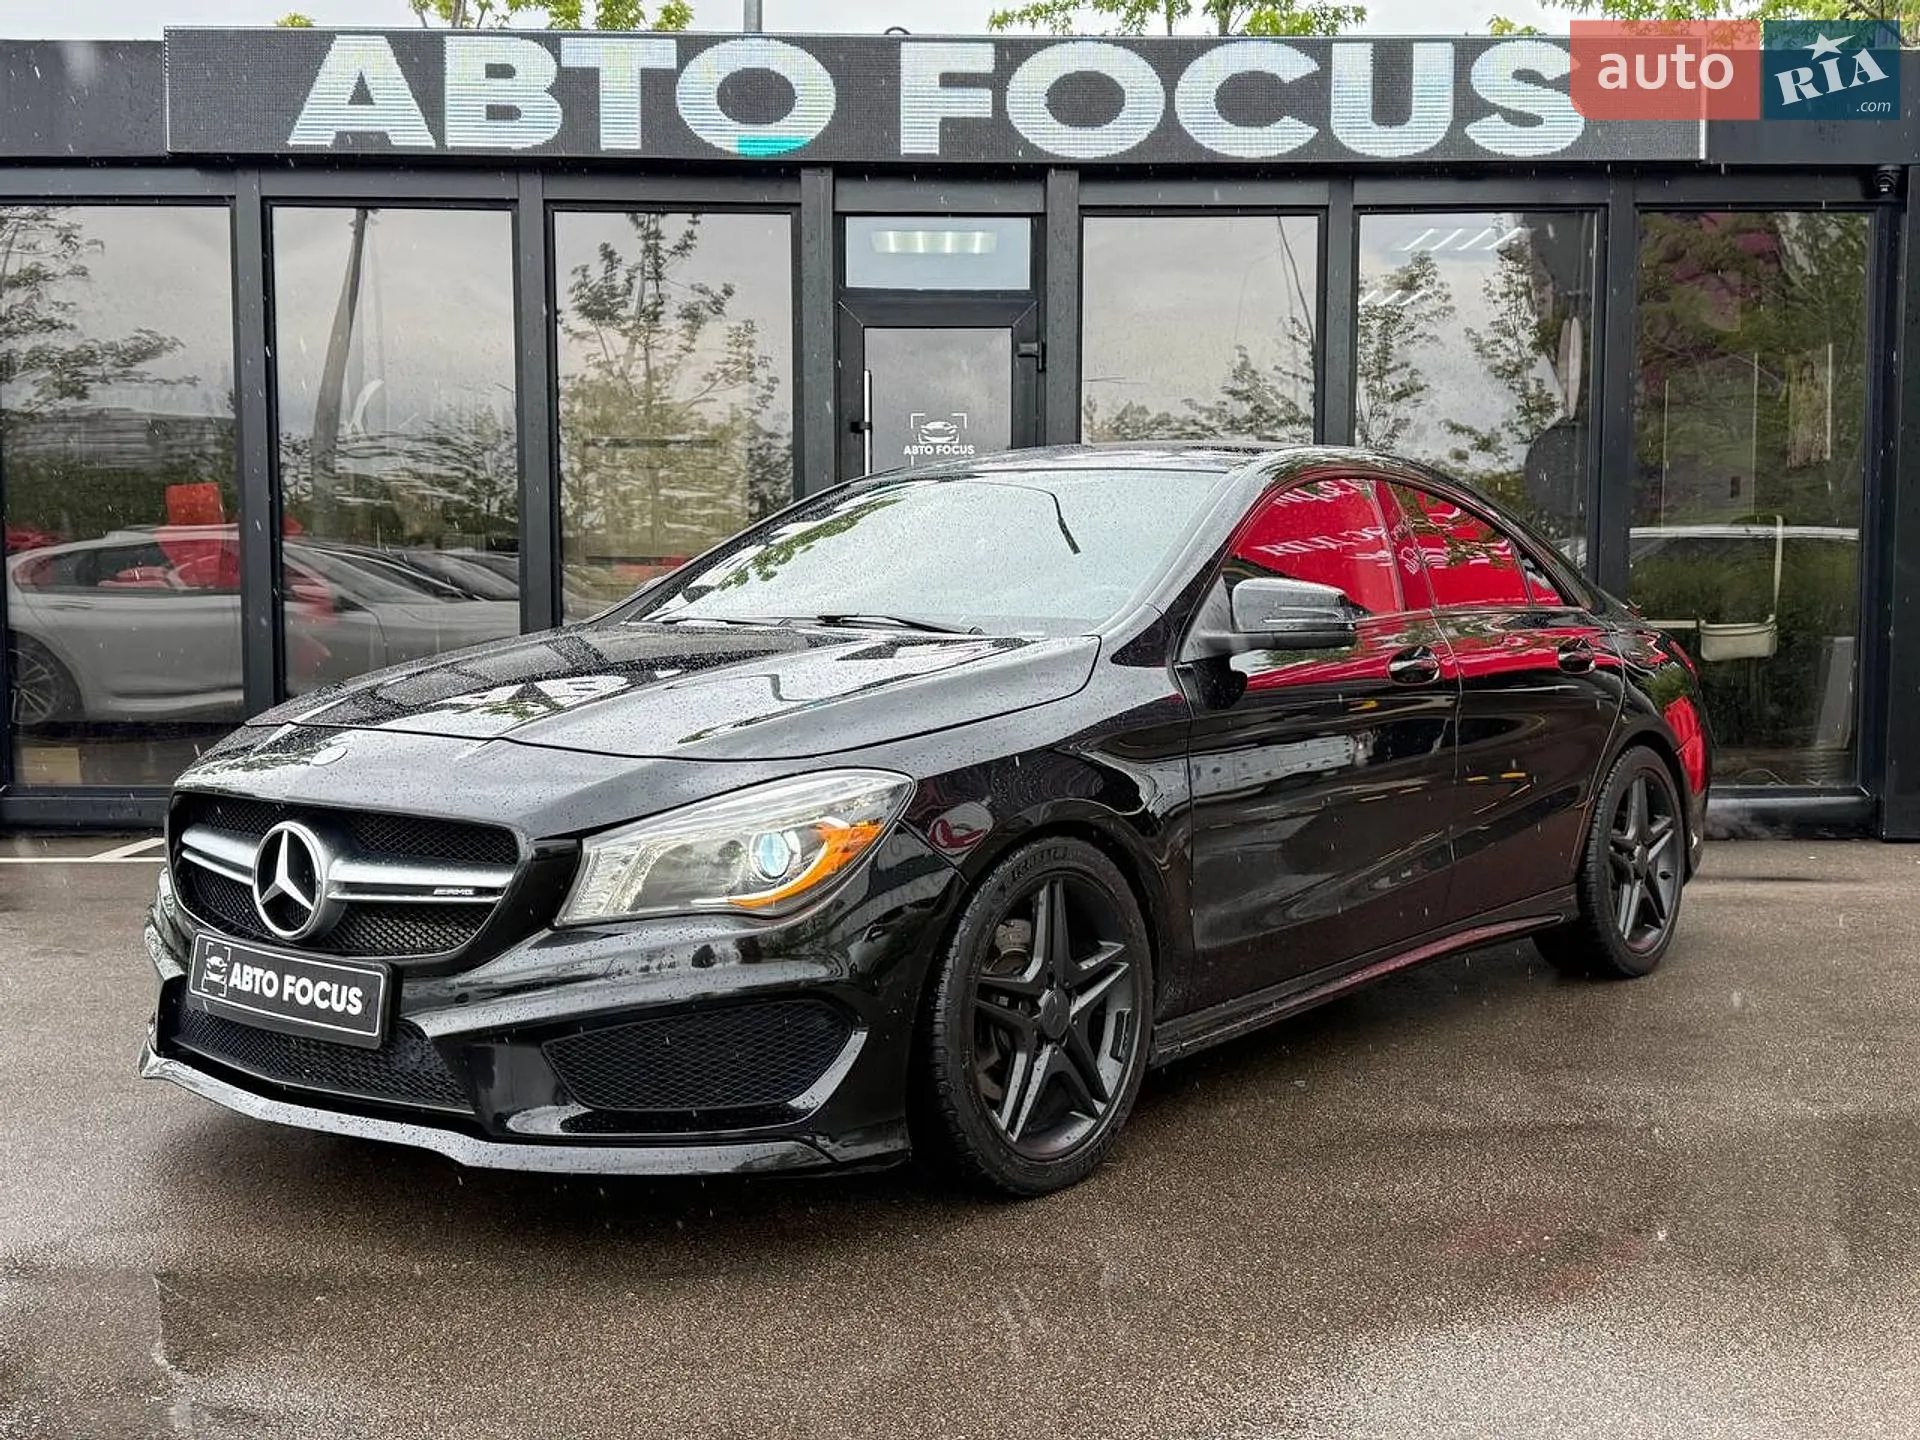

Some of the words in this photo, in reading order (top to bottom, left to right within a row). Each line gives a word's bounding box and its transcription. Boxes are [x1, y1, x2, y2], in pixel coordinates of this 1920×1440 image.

[287, 35, 836, 157] АВТО
[900, 40, 1585, 159] FOCUS
[903, 444, 934, 455] АВТО
[935, 444, 975, 455] FOCUS
[229, 962, 279, 998] АВТО
[282, 974, 363, 1016] FOCUS
